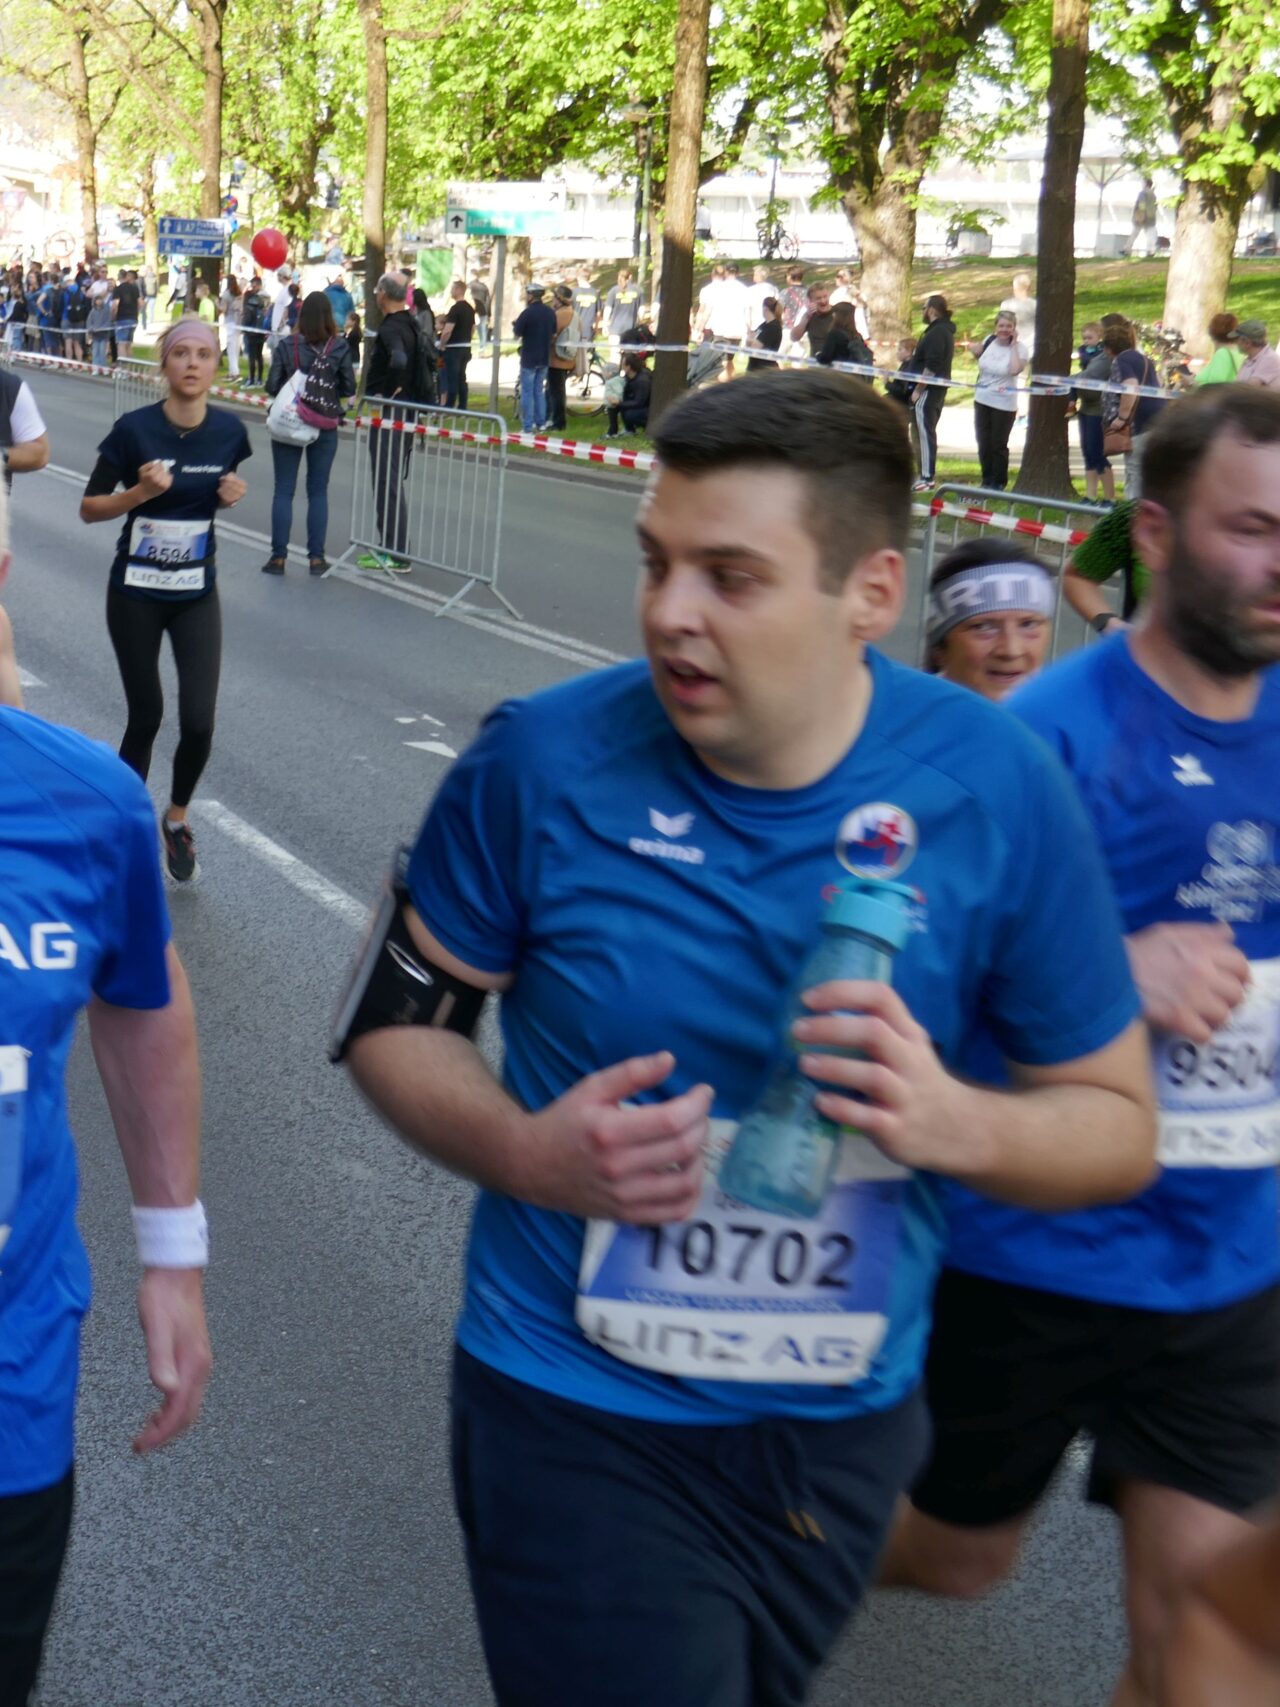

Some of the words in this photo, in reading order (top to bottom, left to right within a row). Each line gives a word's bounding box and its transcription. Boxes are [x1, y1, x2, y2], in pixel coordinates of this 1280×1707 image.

[148, 545, 193, 564] 8594
[638, 1218, 856, 1291] 10702
[760, 1335, 864, 1370] AG
